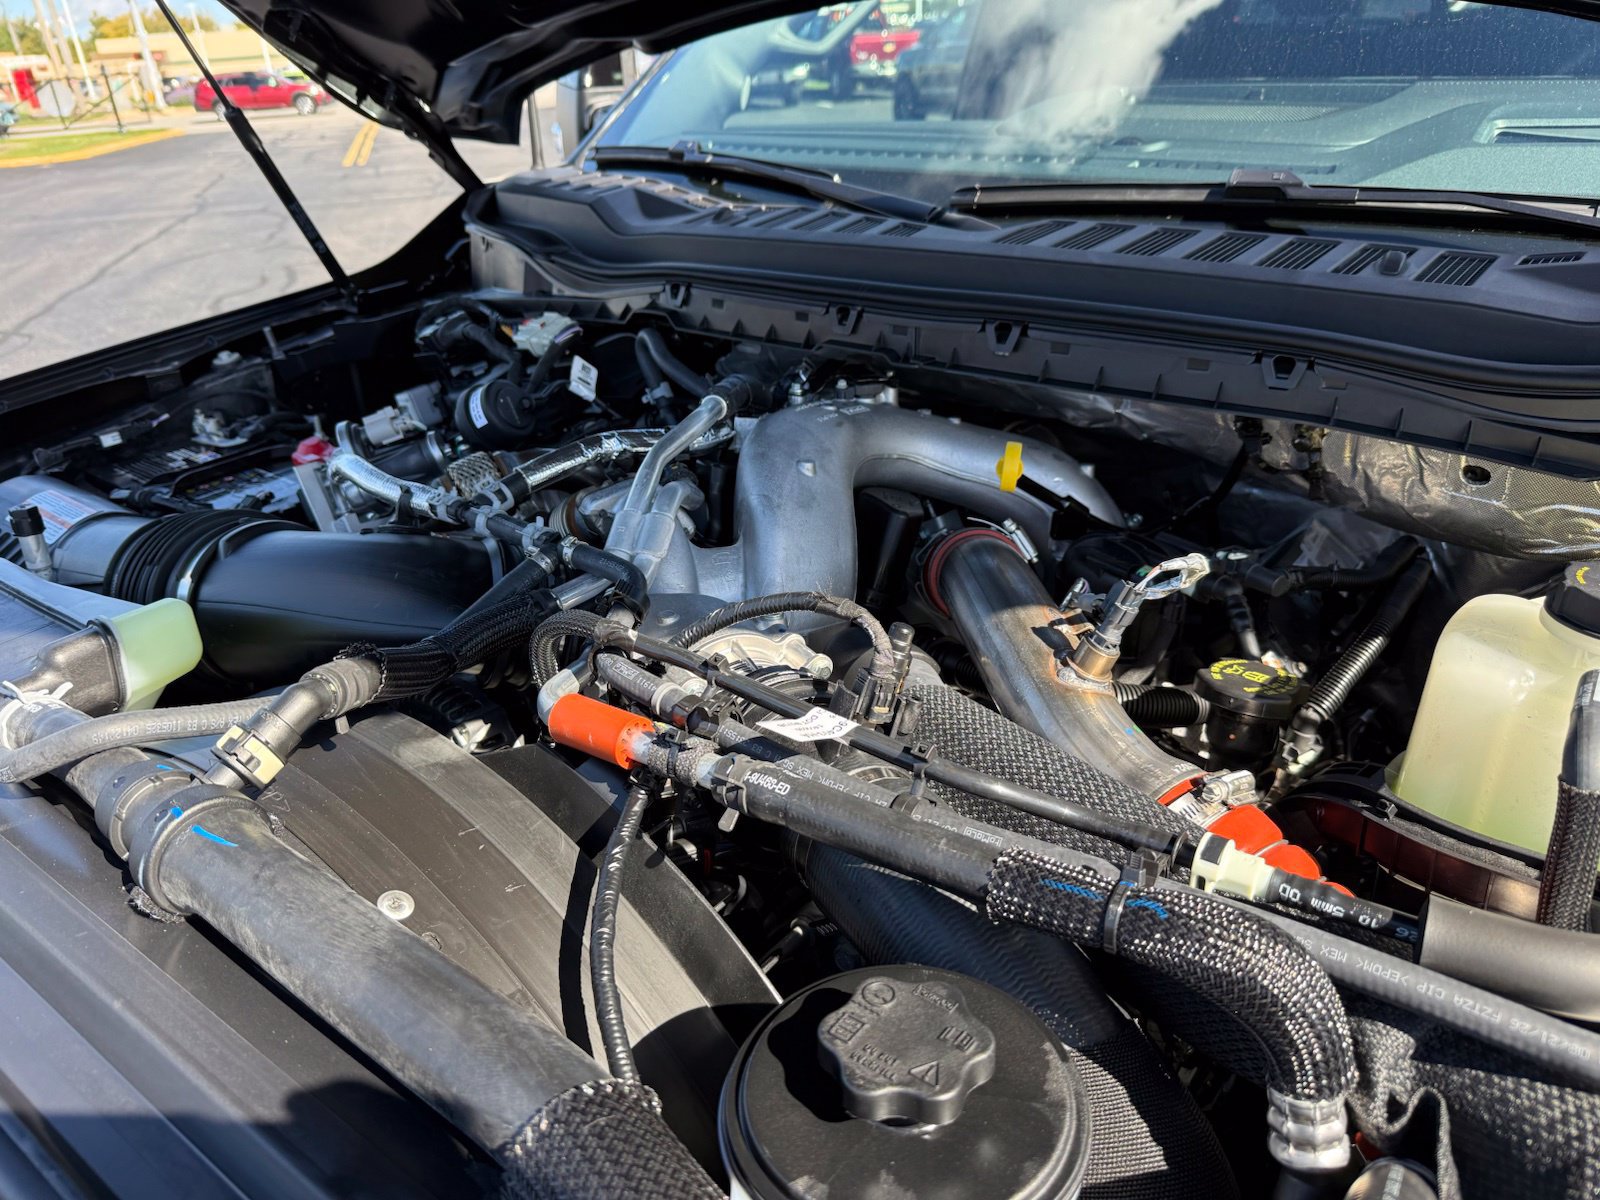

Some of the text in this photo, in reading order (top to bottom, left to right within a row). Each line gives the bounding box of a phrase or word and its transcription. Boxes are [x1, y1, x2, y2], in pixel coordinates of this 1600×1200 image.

[186, 718, 198, 729] B3
[1278, 883, 1302, 903] OD
[1319, 944, 1347, 962] MEX
[1416, 980, 1446, 999] CIP
